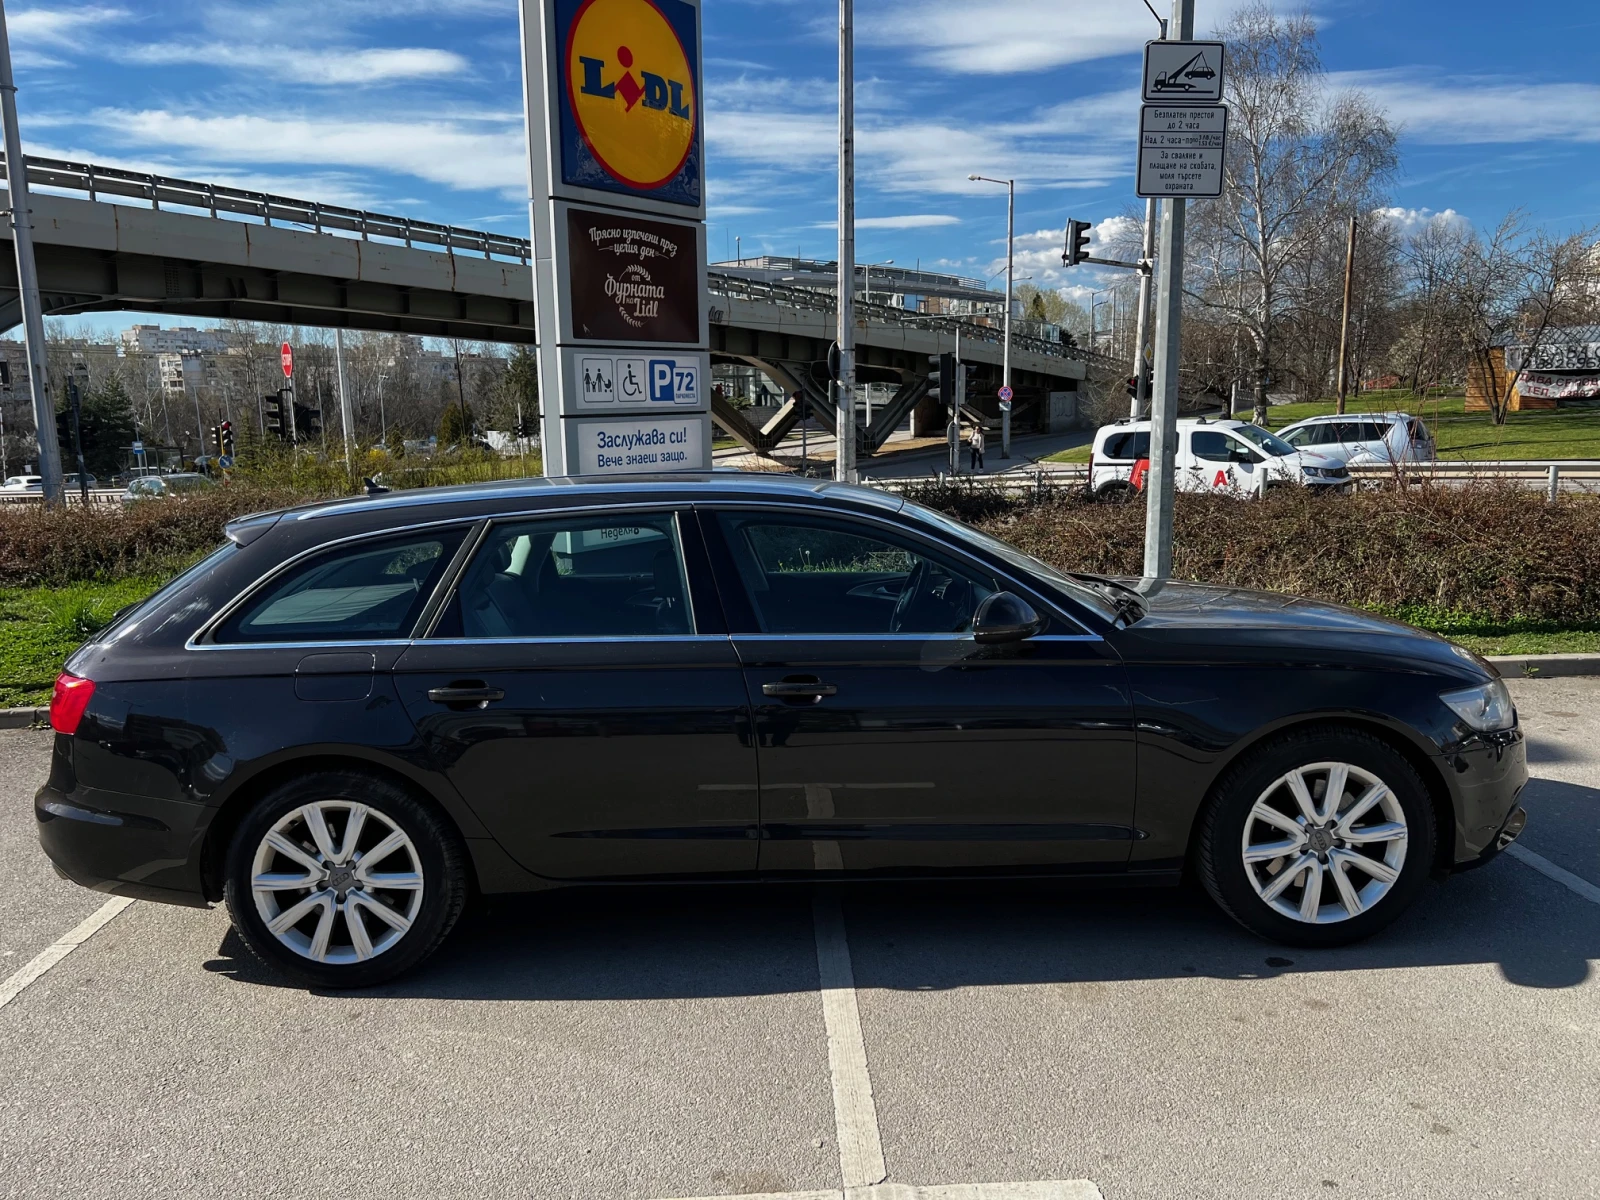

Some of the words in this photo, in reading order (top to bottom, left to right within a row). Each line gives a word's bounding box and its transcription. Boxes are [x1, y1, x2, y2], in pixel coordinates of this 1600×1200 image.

[1154, 110, 1187, 119] Безплатен
[1190, 111, 1214, 120] престой
[1178, 121, 1183, 129] 2
[1144, 135, 1157, 144] Над
[1160, 135, 1164, 144] 2
[1160, 151, 1168, 159] За
[1149, 162, 1176, 170] плащане
[1190, 161, 1217, 170] скобата,
[1177, 173, 1201, 181] търсете
[589, 227, 621, 246] Прясно
[622, 229, 659, 244] изпечени
[660, 238, 678, 257] през
[614, 243, 638, 256] целия
[640, 246, 655, 260] ден
[605, 273, 665, 304] Фурната
[633, 298, 659, 317] Lidl
[654, 364, 671, 398] P
[675, 372, 694, 392] 72
[597, 429, 665, 450] Заслужава
[670, 427, 687, 443] си!
[598, 454, 623, 467] Вече
[626, 453, 657, 466] знаеш
[661, 451, 687, 463] защо.
